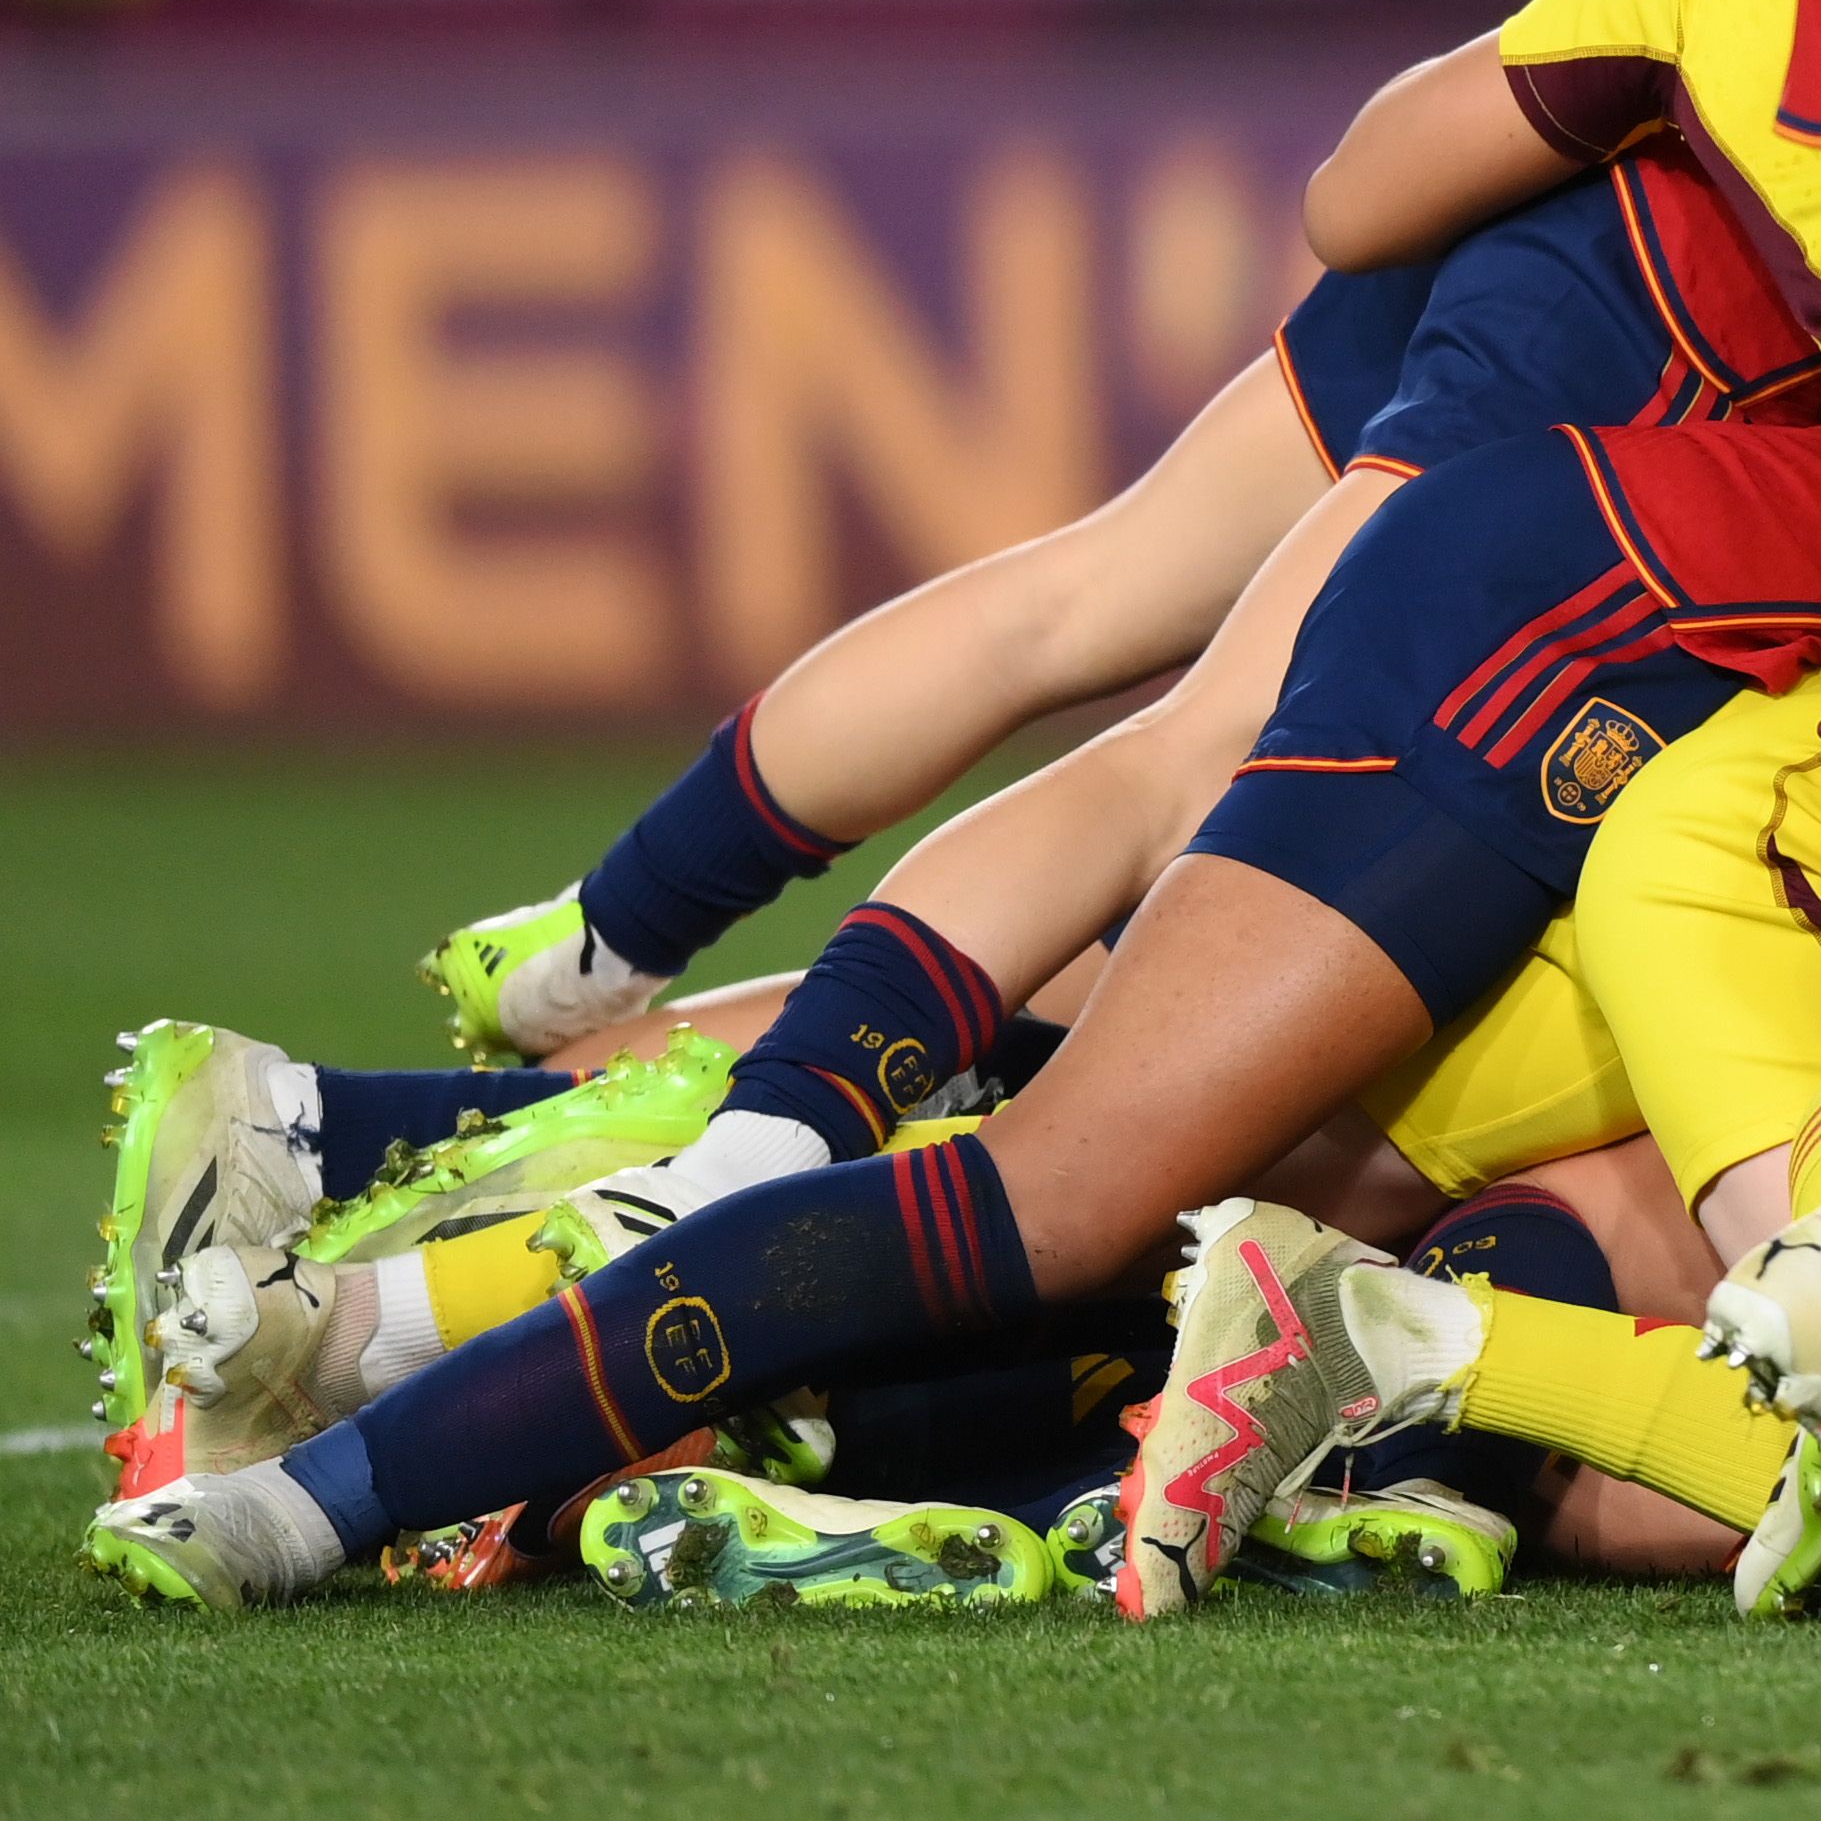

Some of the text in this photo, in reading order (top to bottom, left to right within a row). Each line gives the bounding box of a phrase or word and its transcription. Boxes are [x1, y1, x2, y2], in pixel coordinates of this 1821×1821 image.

[0, 145, 1320, 715] MEN'
[850, 1023, 886, 1050] 19
[654, 1261, 681, 1292] 19
